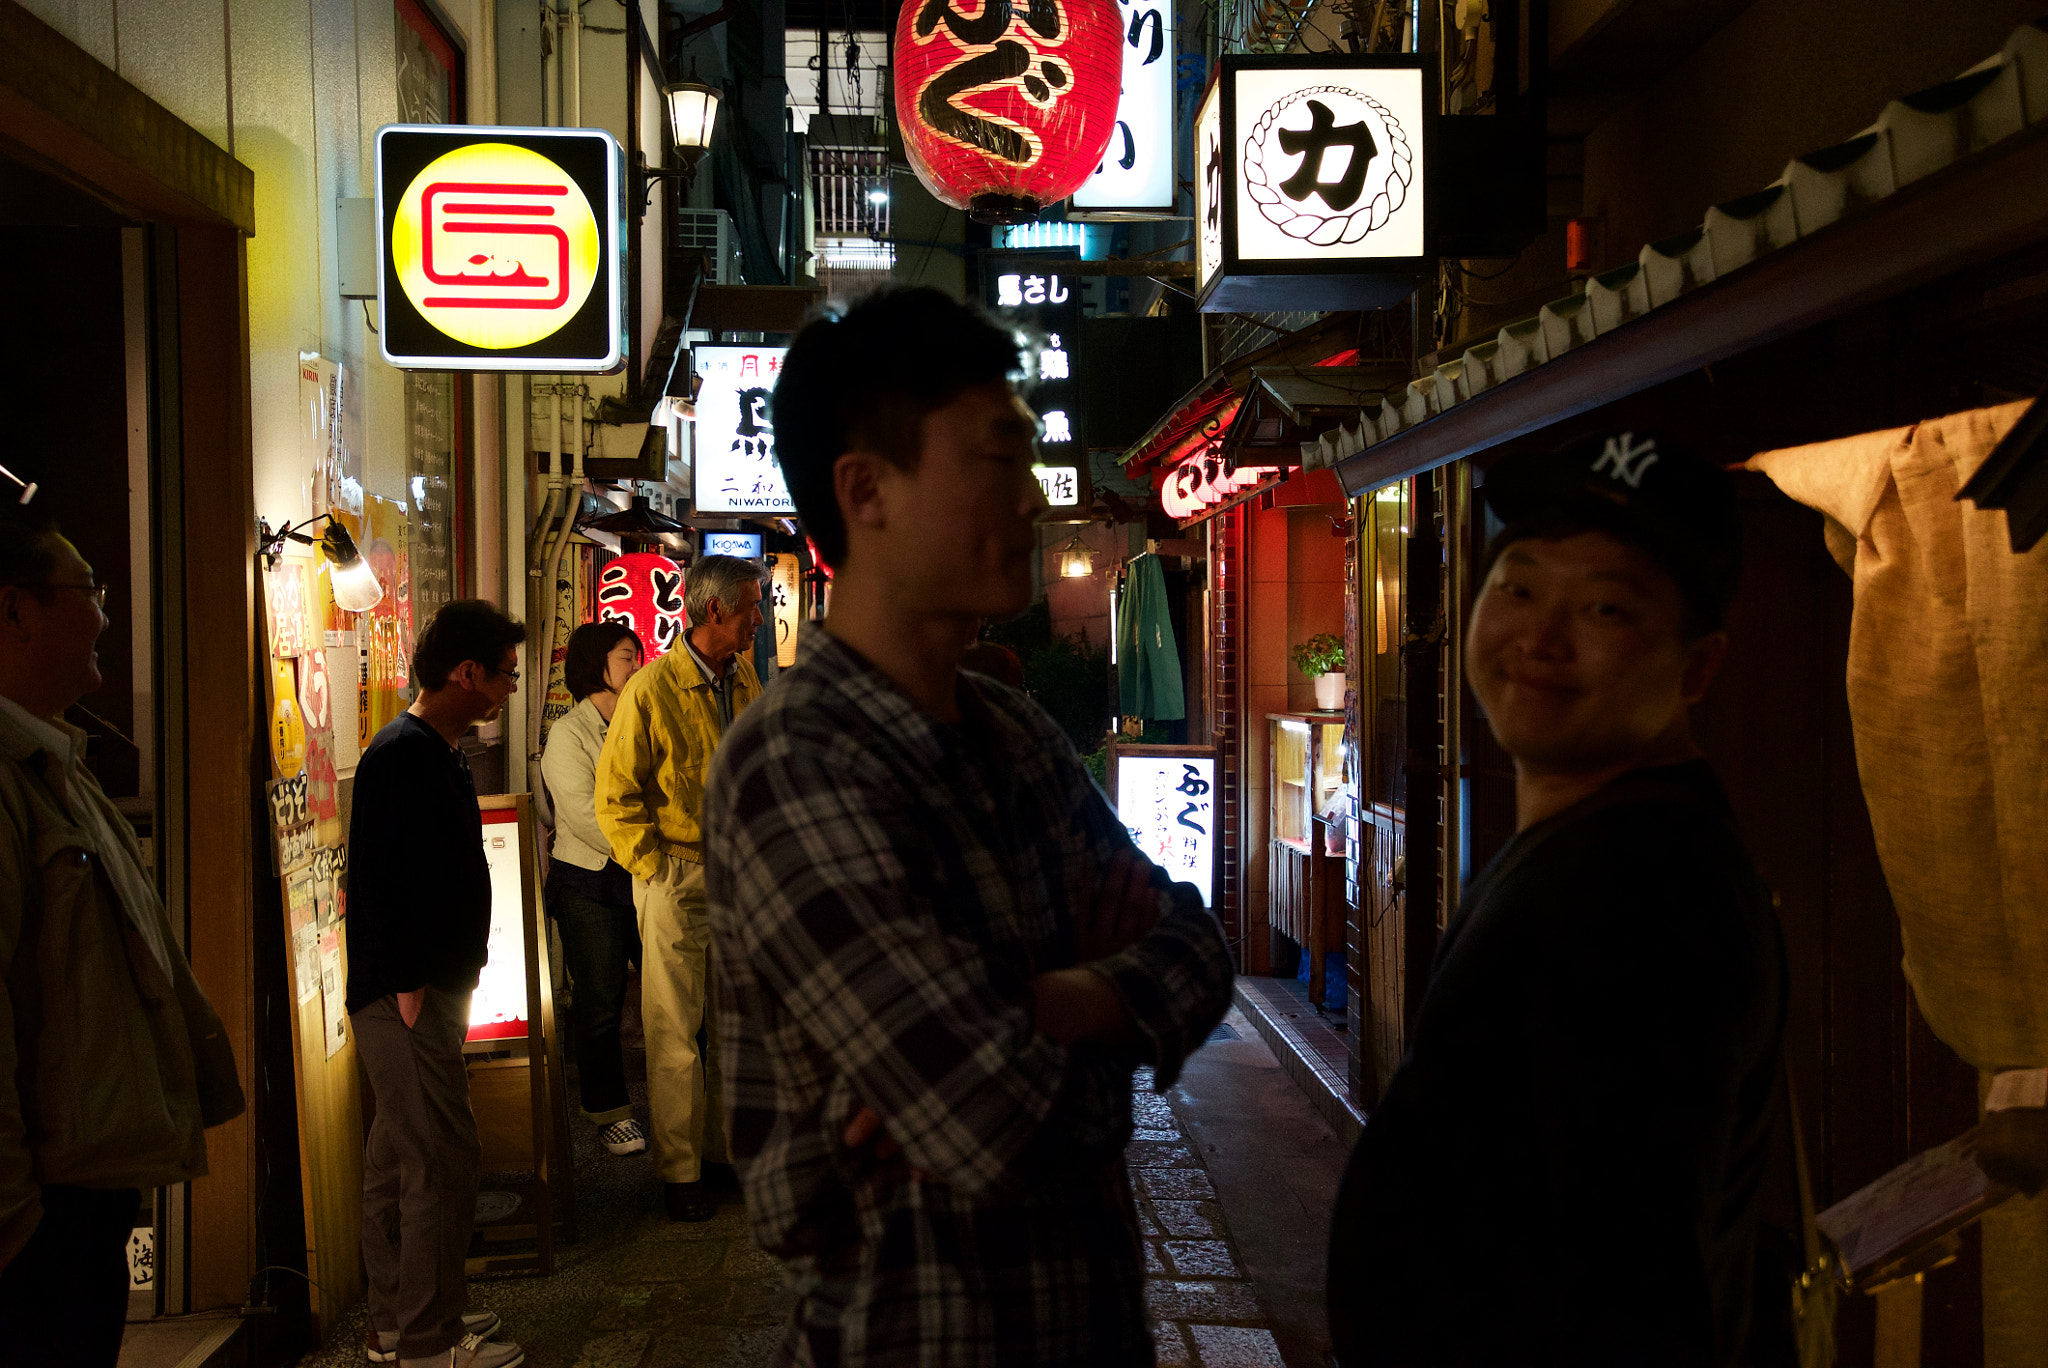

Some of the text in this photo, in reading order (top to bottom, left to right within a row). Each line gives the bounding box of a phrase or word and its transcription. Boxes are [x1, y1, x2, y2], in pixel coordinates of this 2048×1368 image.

[1278, 99, 1378, 212] 力
[997, 274, 1069, 306] 馬さし
[303, 368, 319, 383] KIRIN
